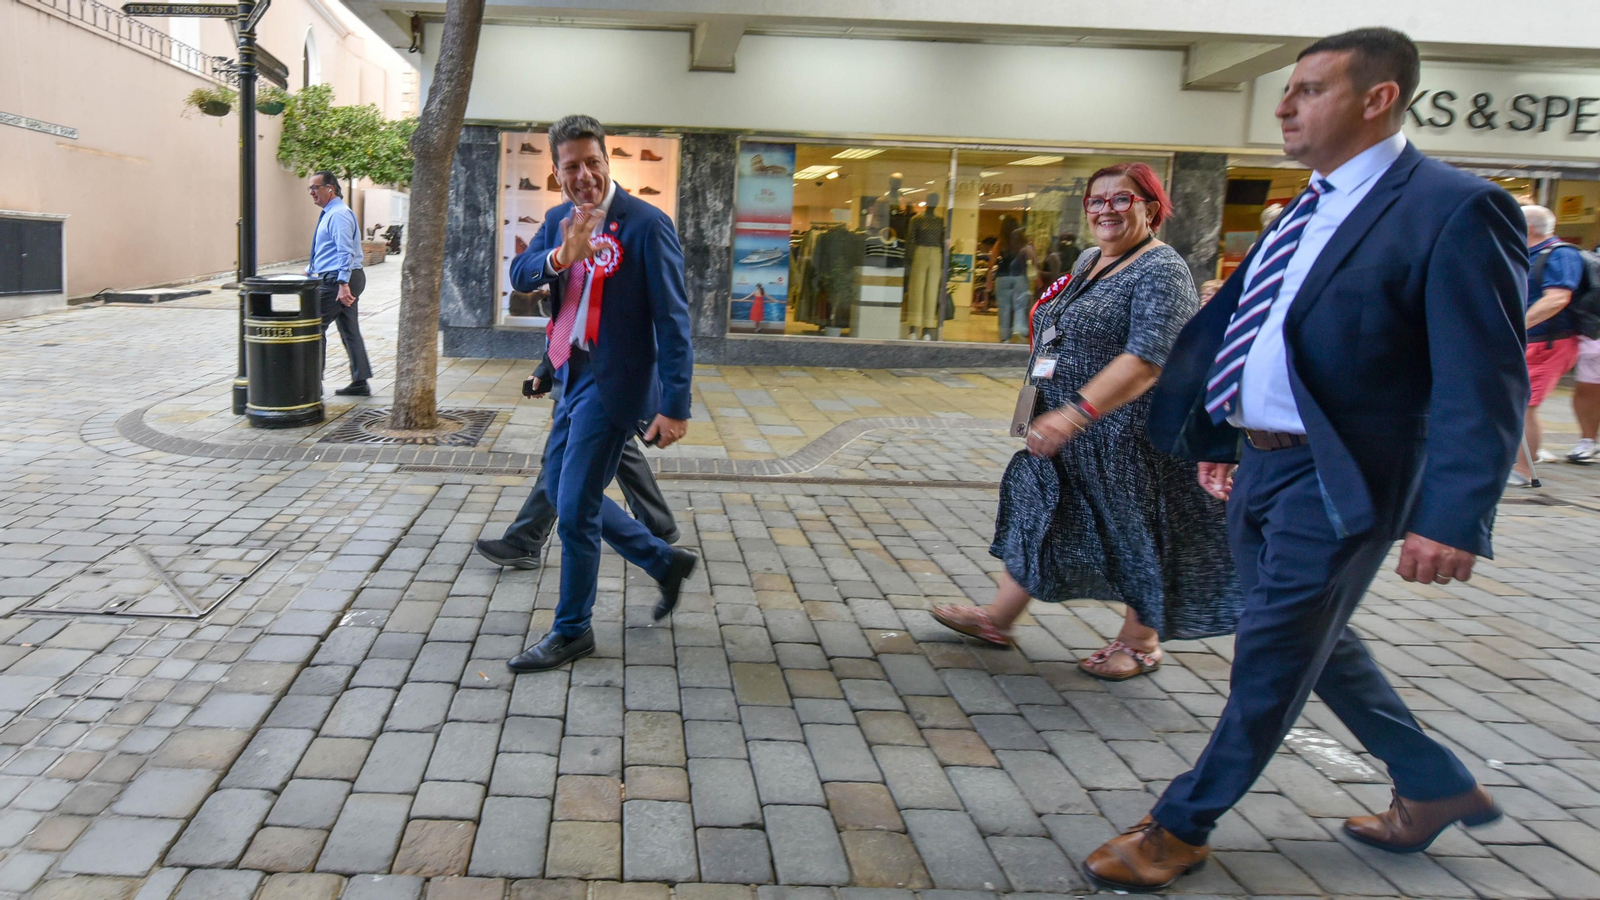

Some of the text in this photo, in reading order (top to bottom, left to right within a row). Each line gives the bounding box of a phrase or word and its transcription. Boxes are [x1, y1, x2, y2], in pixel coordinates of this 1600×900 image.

[128, 5, 237, 14] TOURIST INFORMATION
[1467, 92, 1499, 130] &
[1506, 94, 1600, 134] SPE
[255, 327, 293, 337] LITTER
